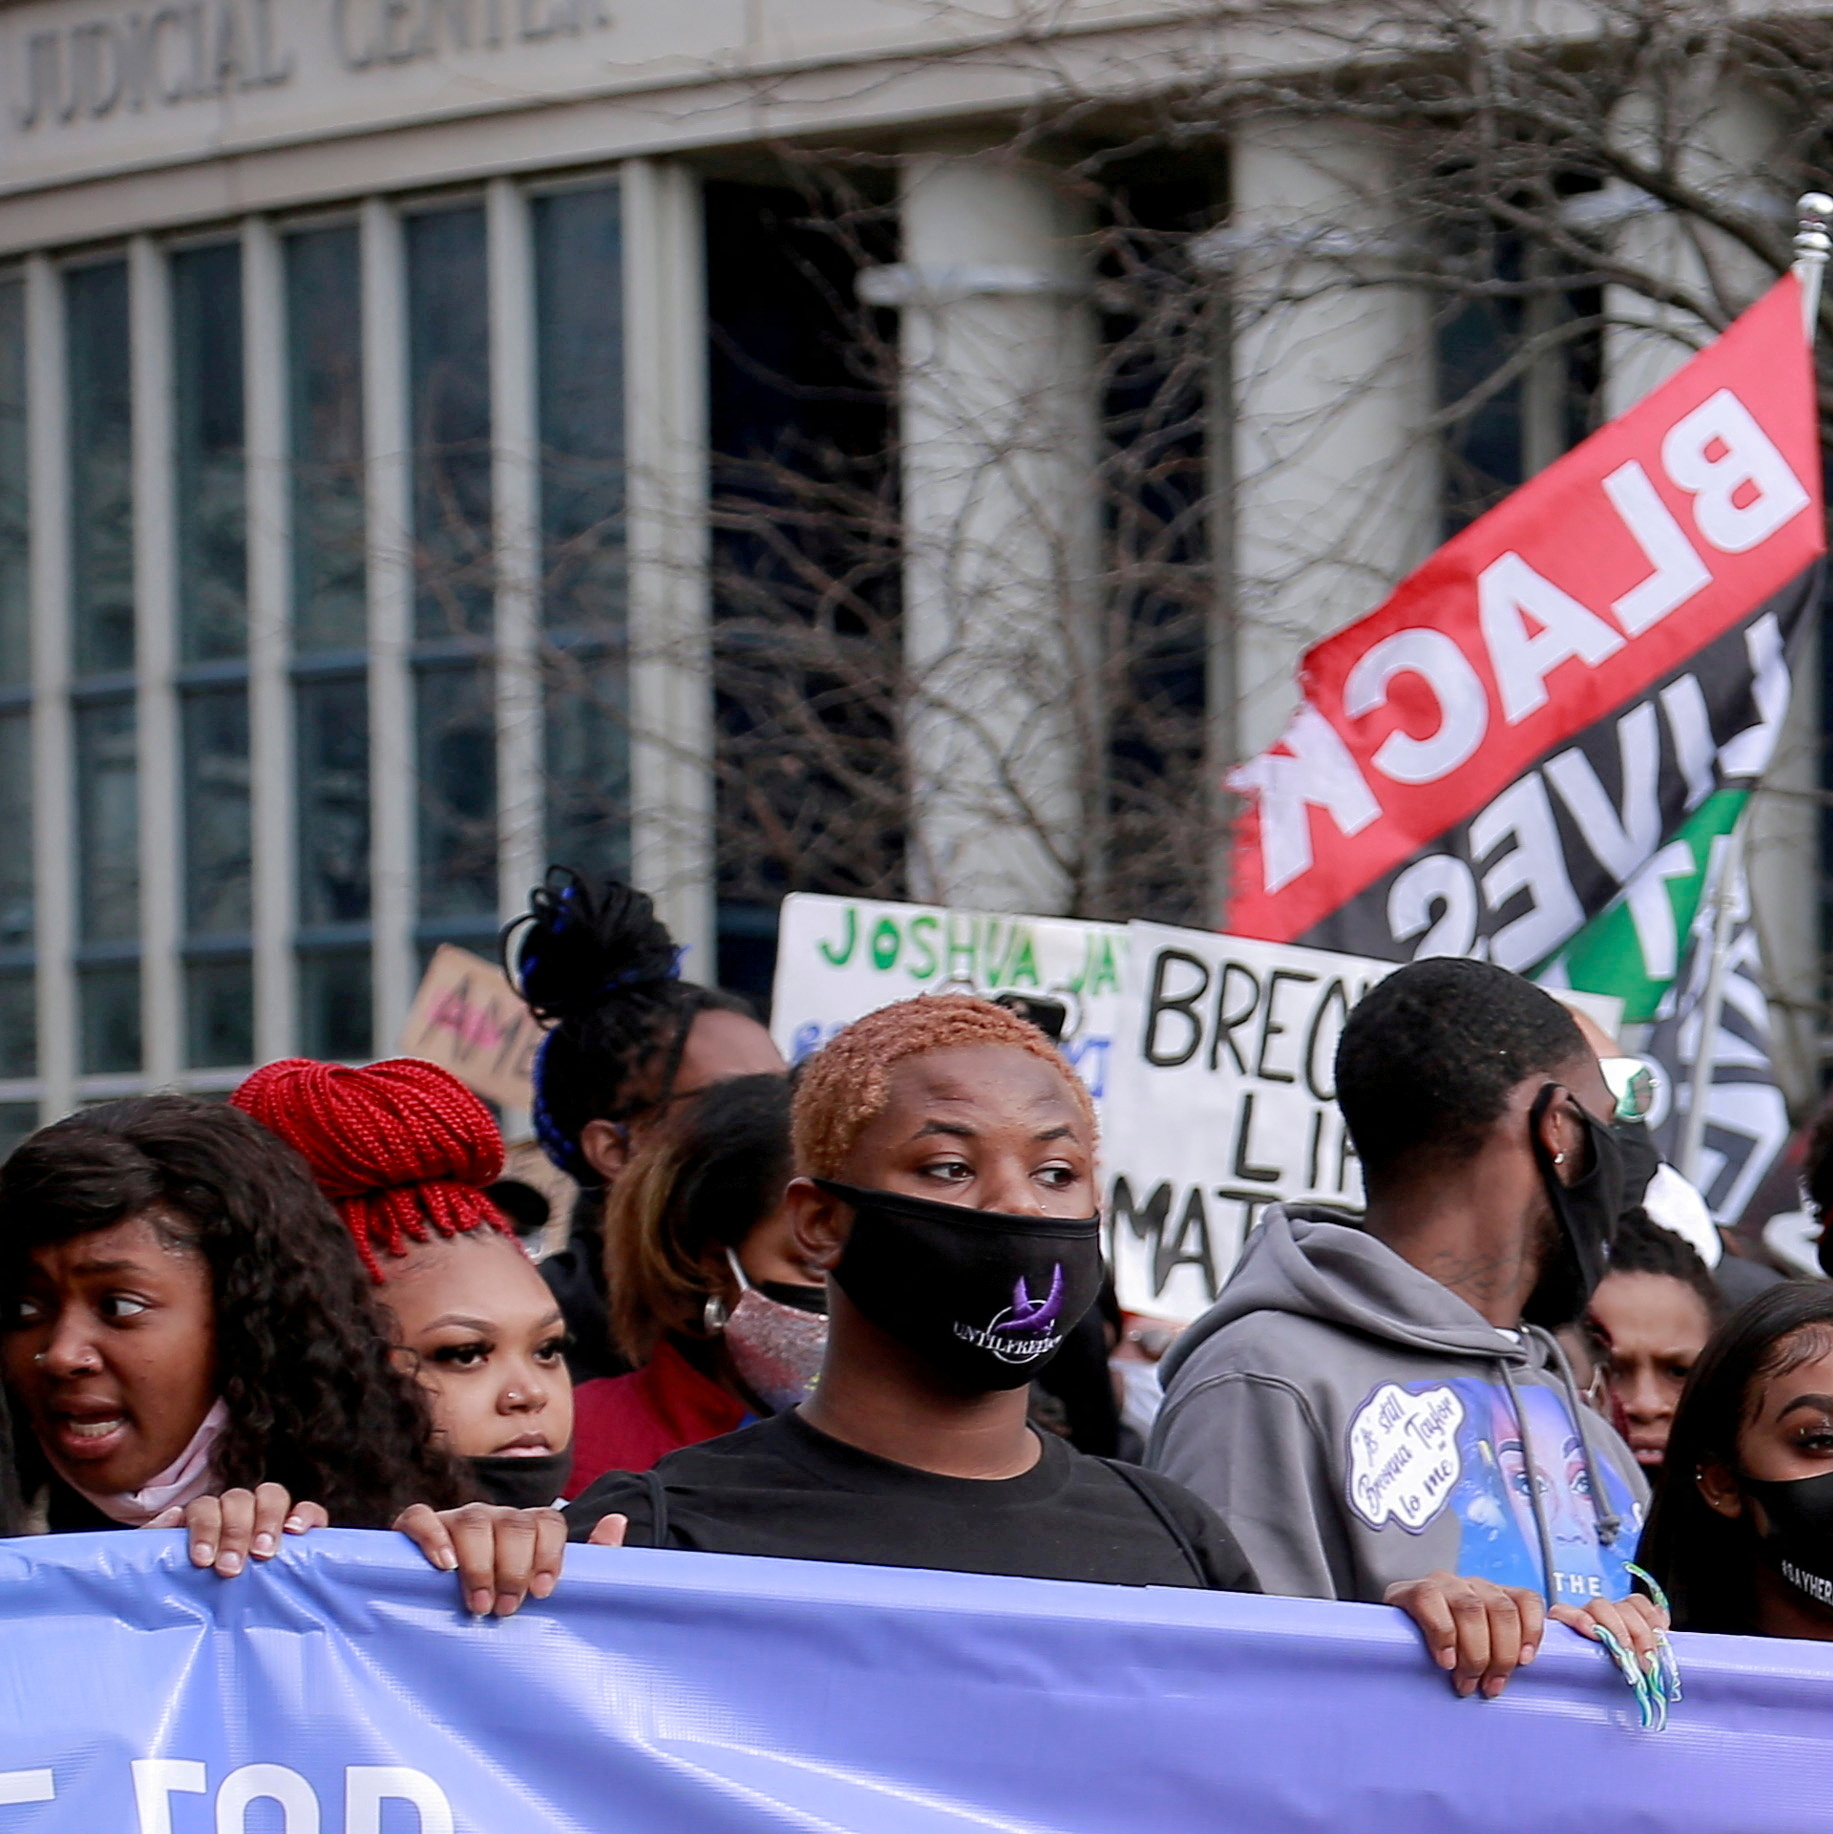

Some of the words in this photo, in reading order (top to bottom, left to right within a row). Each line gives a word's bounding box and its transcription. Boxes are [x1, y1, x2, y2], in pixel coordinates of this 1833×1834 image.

[18, 0, 293, 132] JUDICIAL
[820, 906, 1040, 988] JOSHUA
[1145, 949, 1370, 1103] BREO
[1553, 1571, 1602, 1597] THE
